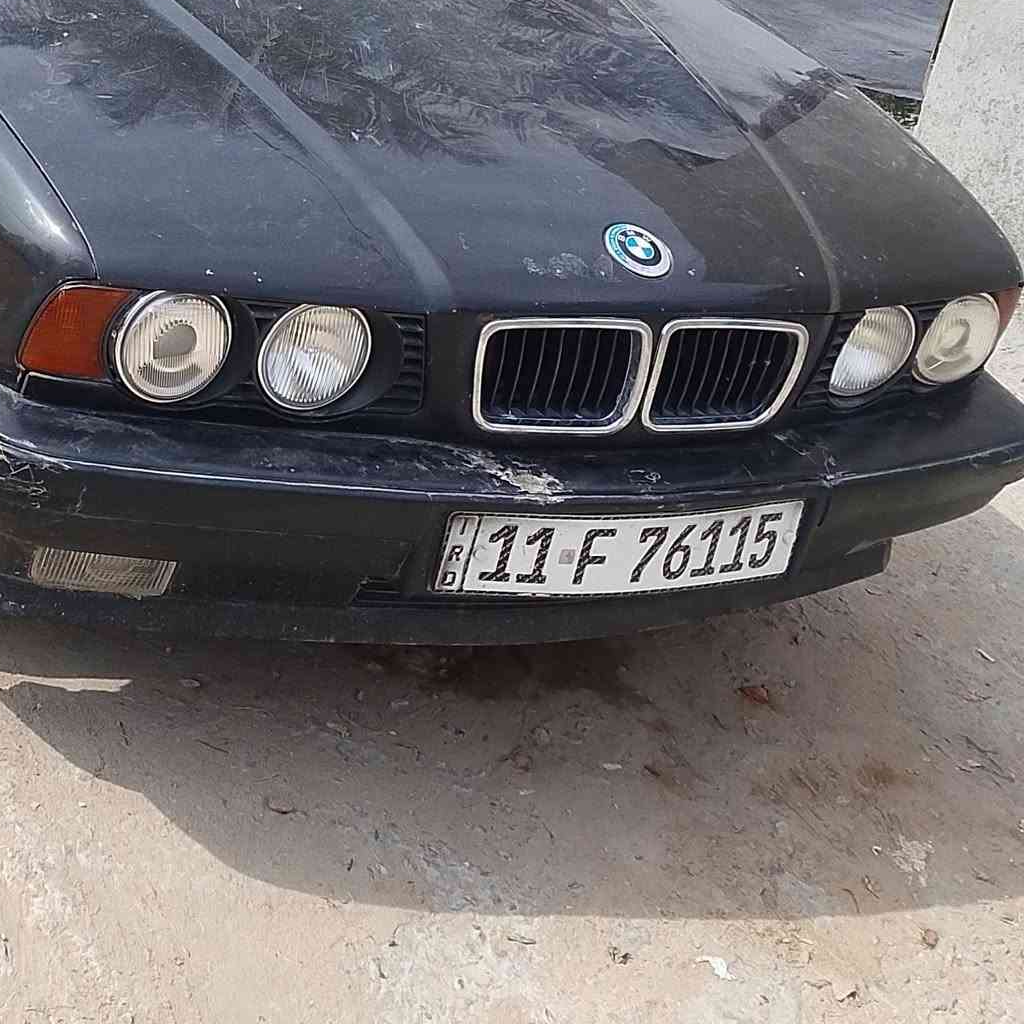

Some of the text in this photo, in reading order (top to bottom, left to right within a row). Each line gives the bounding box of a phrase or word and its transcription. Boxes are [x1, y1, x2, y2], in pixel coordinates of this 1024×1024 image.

[478, 512, 783, 585] 11 F 76115
